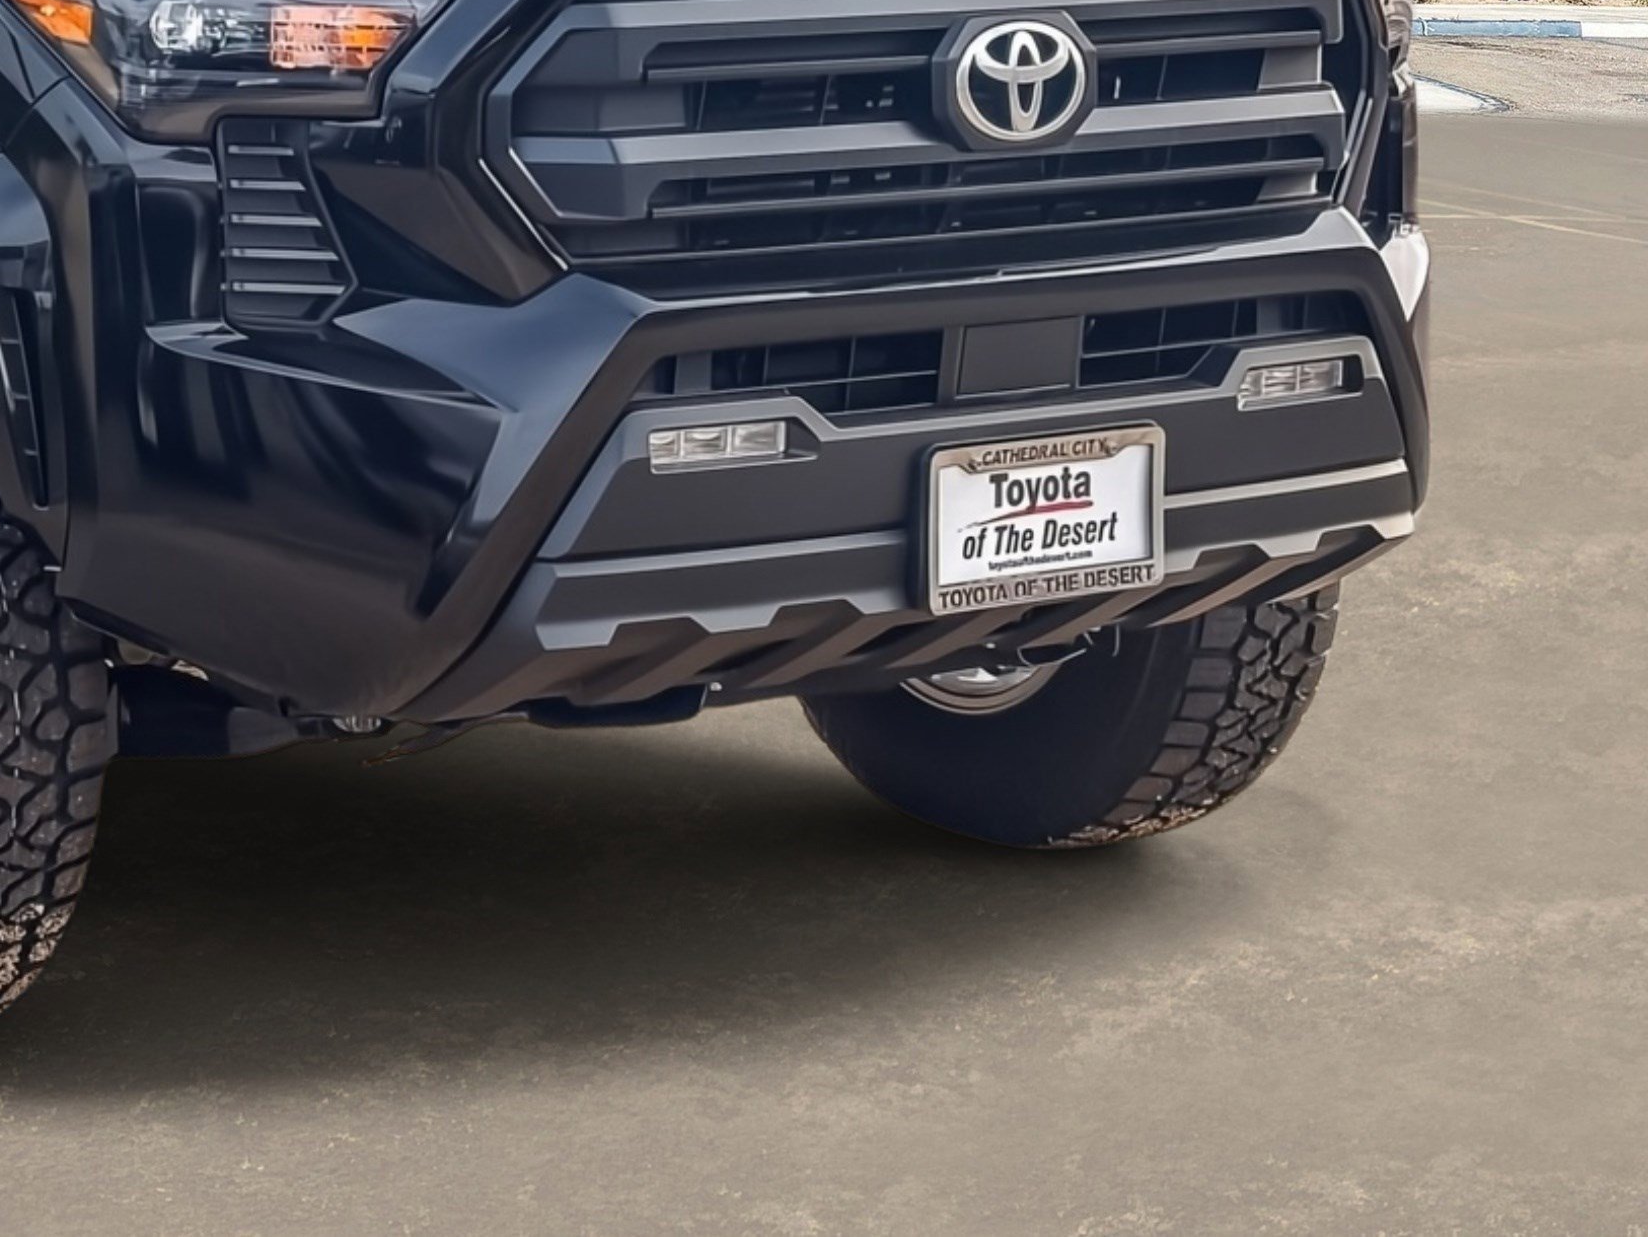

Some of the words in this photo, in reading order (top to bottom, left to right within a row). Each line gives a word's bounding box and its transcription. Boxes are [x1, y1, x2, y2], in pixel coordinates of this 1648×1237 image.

[982, 445, 1069, 466] CATHEDRAL
[1071, 437, 1109, 456] CITY
[989, 466, 1092, 513] Toyota
[962, 526, 987, 560] of
[994, 523, 1035, 556] The
[1041, 511, 1118, 550] Desert
[938, 583, 1008, 609] TOYOTA
[1014, 578, 1042, 598] OF
[1042, 572, 1079, 594] THE
[1083, 563, 1155, 589] DESERT
